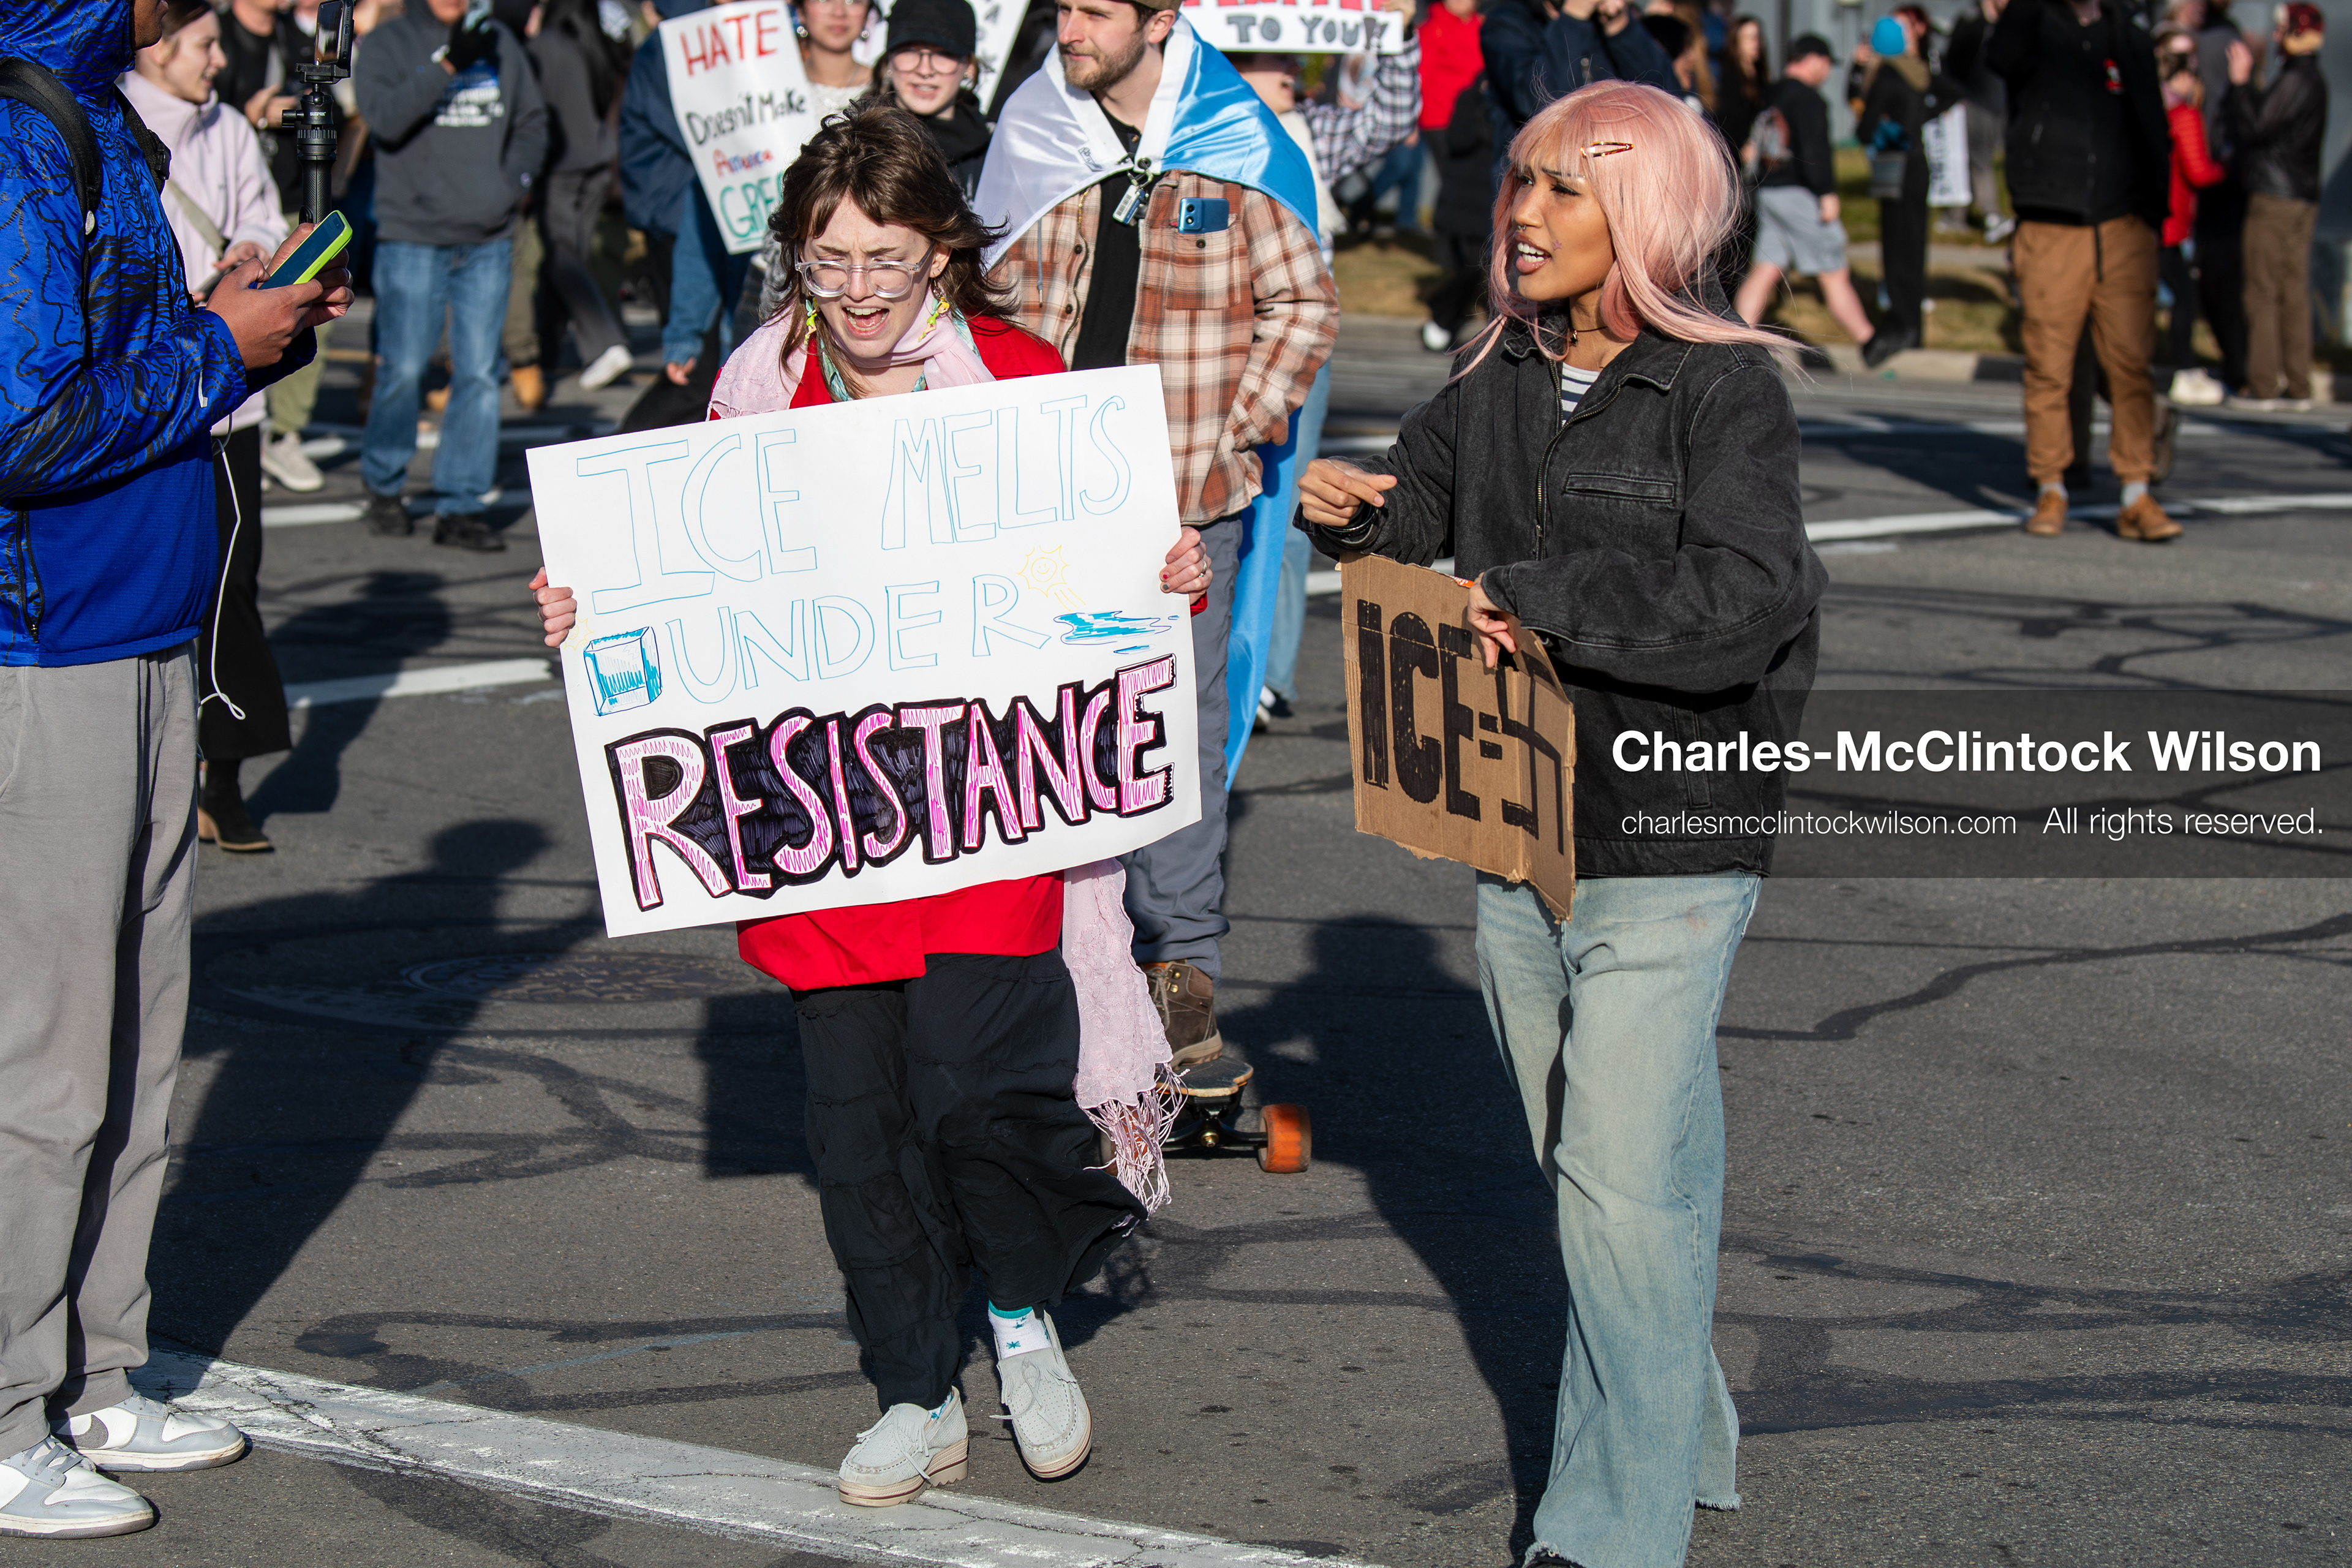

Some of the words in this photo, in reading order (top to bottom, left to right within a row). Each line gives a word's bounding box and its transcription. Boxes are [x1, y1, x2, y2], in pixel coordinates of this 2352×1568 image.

[679, 9, 779, 77] HATE
[1227, 15, 1281, 43] TO
[758, 88, 806, 123] Make
[576, 428, 817, 615] ICE
[881, 394, 1131, 551] MELTS
[665, 573, 1052, 704] UNDER
[605, 654, 1177, 912] RESISTANCE
